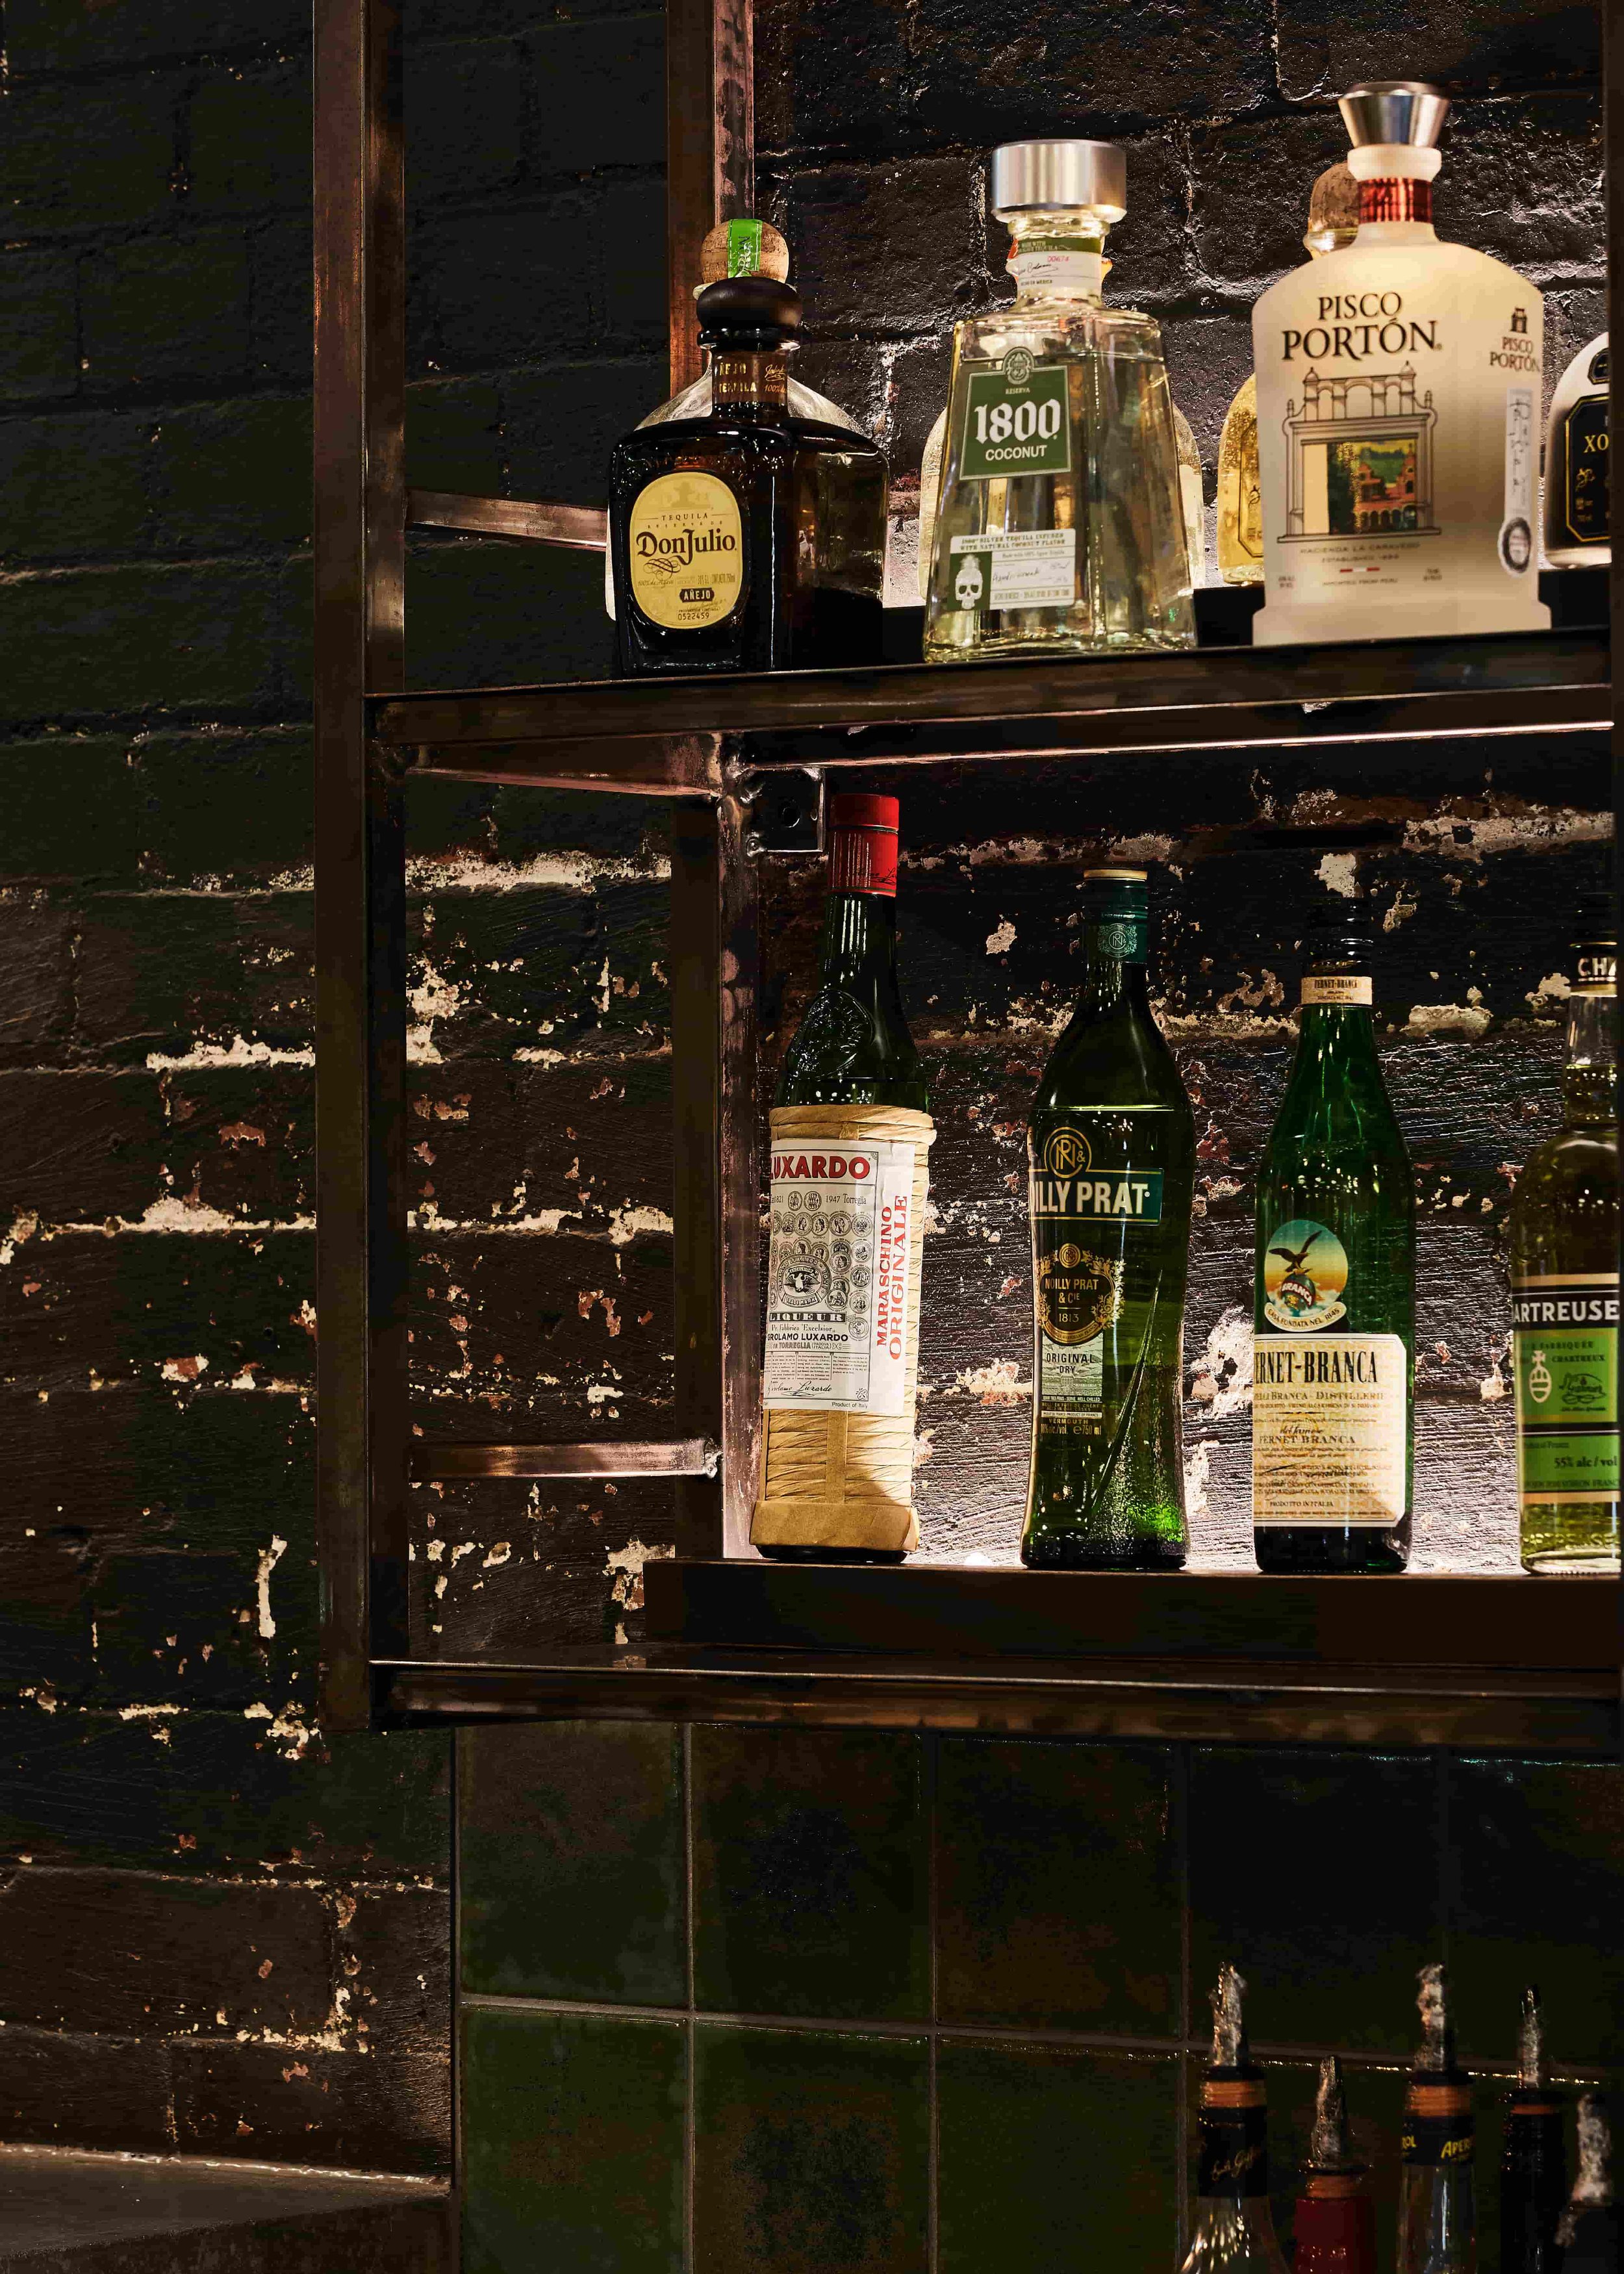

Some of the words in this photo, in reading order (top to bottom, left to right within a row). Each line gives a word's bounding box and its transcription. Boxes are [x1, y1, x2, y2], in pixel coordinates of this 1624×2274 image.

[1318, 292, 1401, 320] PISCO
[1282, 318, 1438, 361] PORTÓN
[1502, 337, 1533, 353] PISCO
[974, 399, 1060, 444] 1800
[1584, 433, 1608, 453] XO
[985, 445, 1047, 461] COCONUT
[684, 589, 710, 600] AÑEJO
[843, 1194, 867, 1205] Torreglia
[1076, 1182, 1148, 1214] PRAT
[877, 1207, 892, 1347] MARASCHINO
[889, 1196, 907, 1360] ORIGINALE
[1045, 1279, 1071, 1290] NOILLY
[1074, 1279, 1098, 1290] PRAT
[1058, 1292, 1065, 1303] &
[1282, 1283, 1312, 1306] BRANCA
[1059, 1313, 1079, 1323] 1813
[1268, 1309, 1280, 1323] CASA
[1281, 1318, 1308, 1327] FONDATA
[802, 1333, 848, 1342] LUXARDO
[1047, 1353, 1095, 1363] ORIGINAL
[1271, 1391, 1308, 1400] BRANCA
[1260, 1435, 1300, 1444] FERNET
[1302, 1435, 1356, 1444] BRANCA
